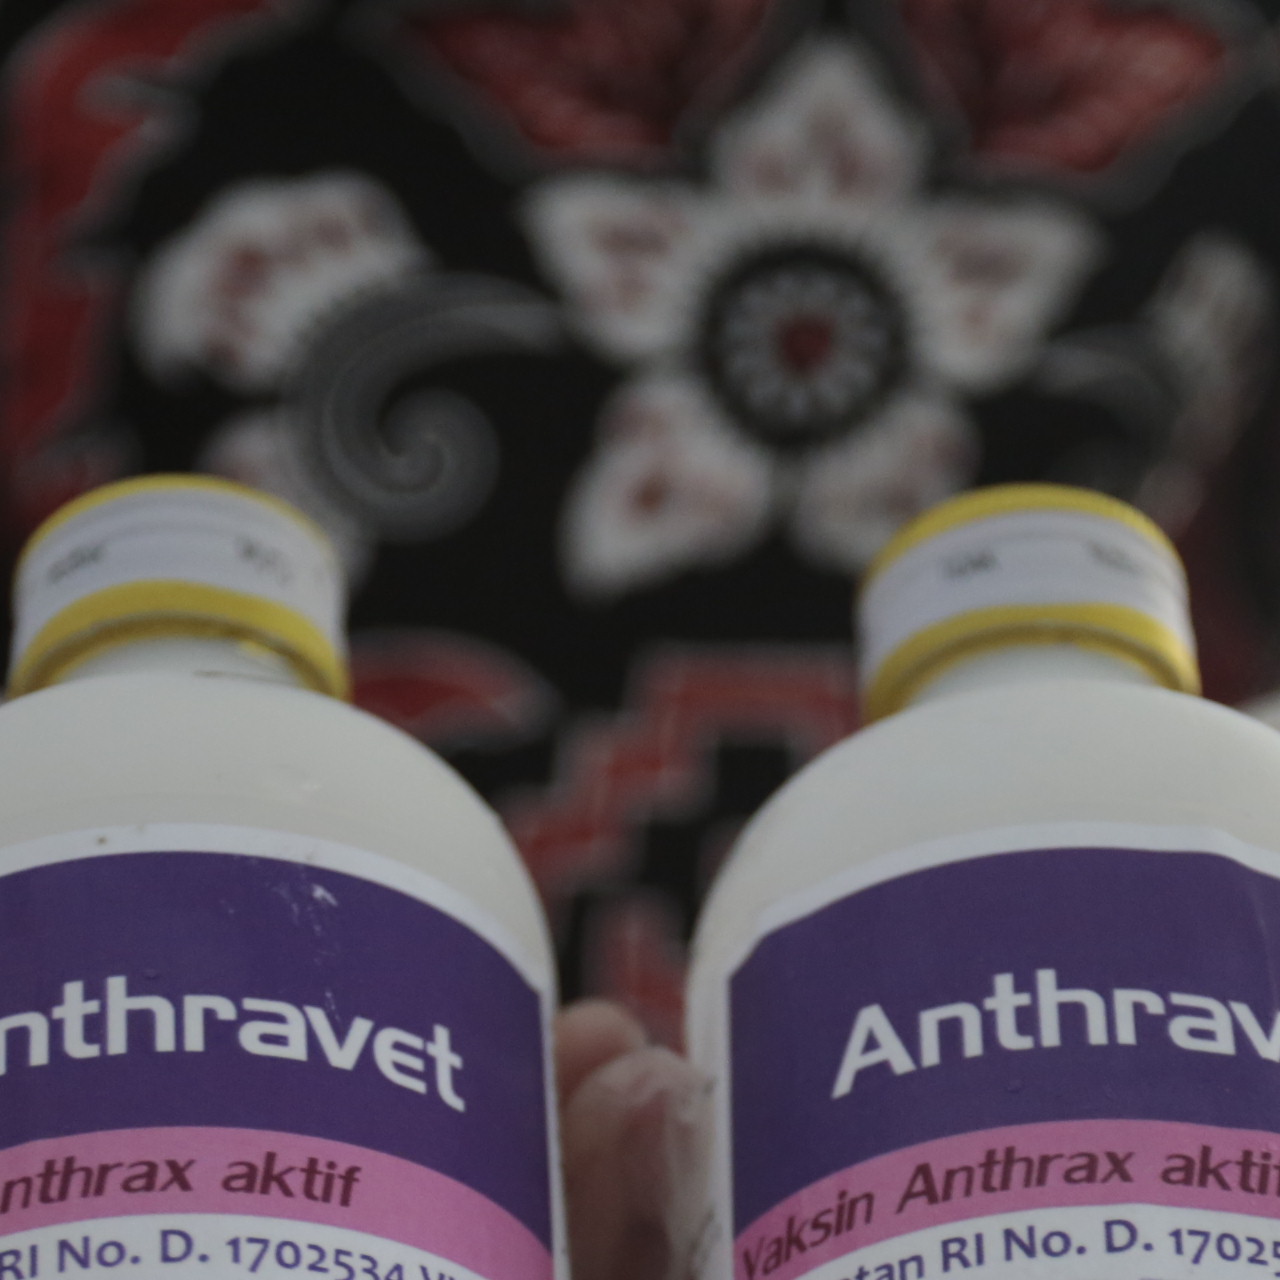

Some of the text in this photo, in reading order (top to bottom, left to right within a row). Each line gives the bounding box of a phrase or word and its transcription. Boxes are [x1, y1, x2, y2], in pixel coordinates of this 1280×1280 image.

[221, 1151, 361, 1207] aktif
[896, 1145, 1133, 1214] Anthrax
[57, 1227, 139, 1273] No.
[159, 1230, 210, 1265] D.
[942, 1235, 984, 1272] RI
[1003, 1224, 1087, 1260] No.
[1104, 1220, 1153, 1255] D.
